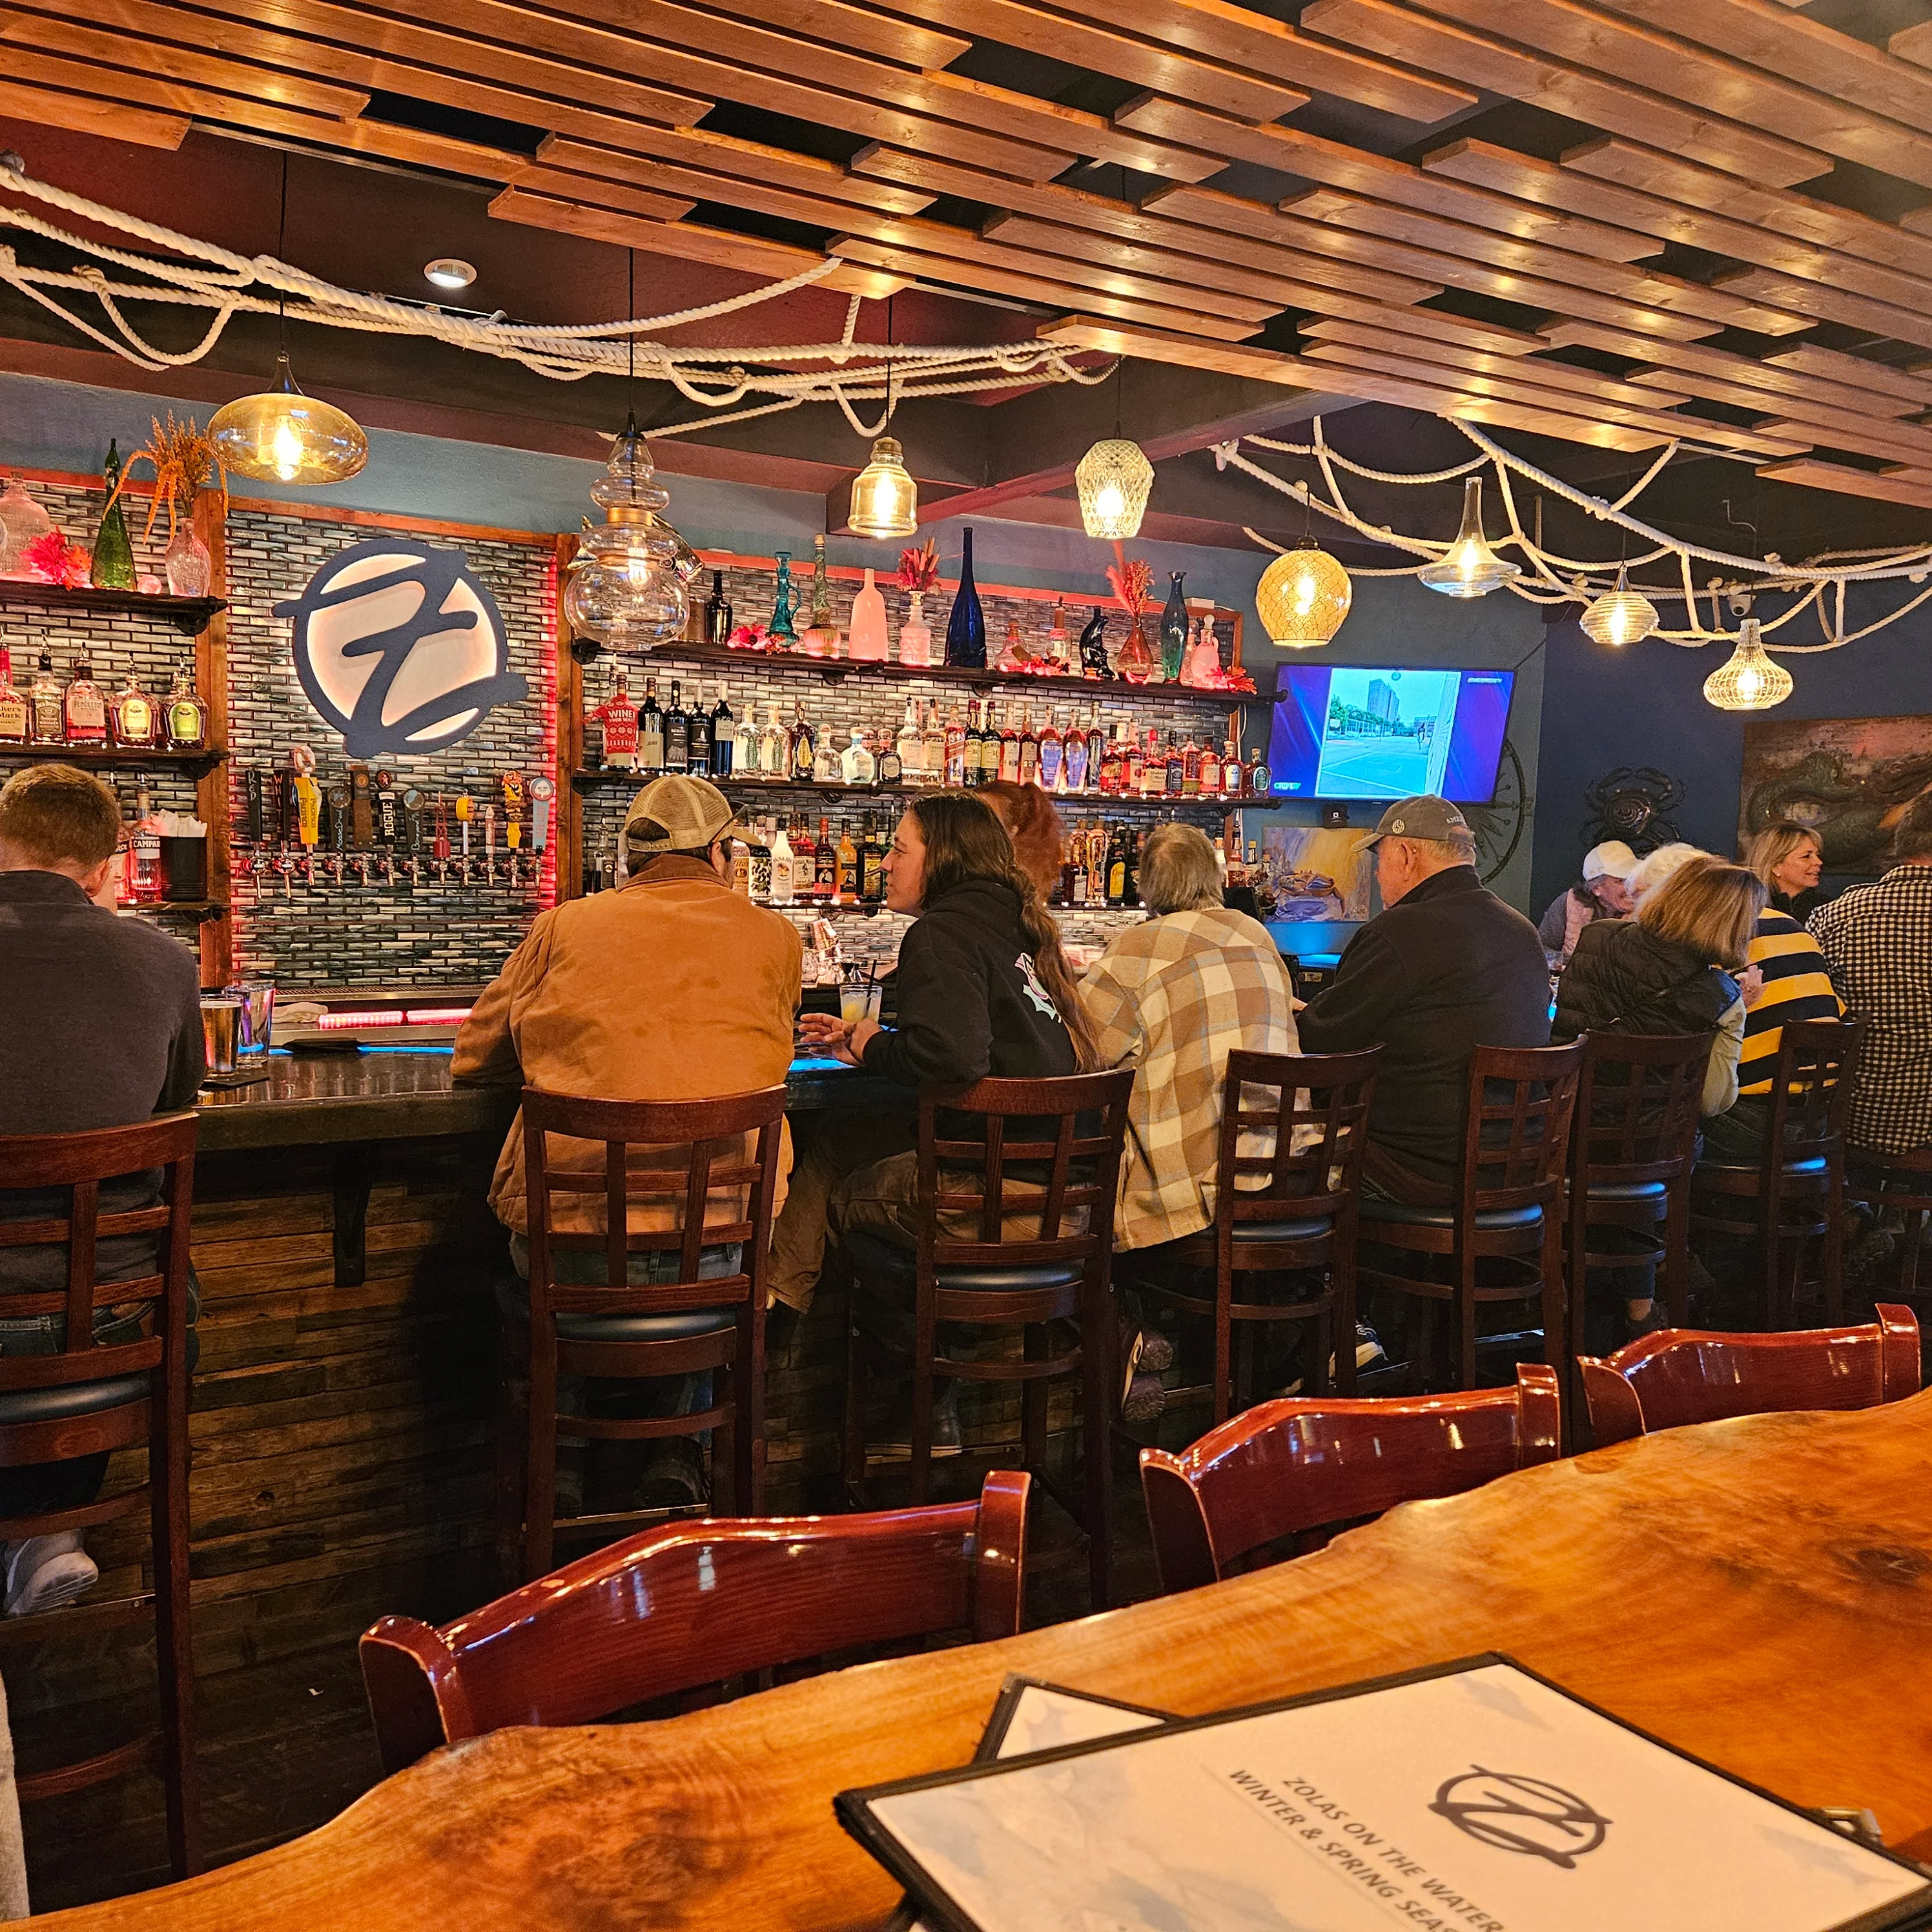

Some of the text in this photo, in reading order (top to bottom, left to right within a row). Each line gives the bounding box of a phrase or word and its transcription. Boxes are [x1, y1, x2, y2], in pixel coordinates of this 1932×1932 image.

[248, 771, 256, 801] RED
[382, 802, 395, 836] ROGUE
[1229, 1769, 1306, 1826] WINTER
[1299, 1827, 1323, 1840] &
[1317, 1842, 1403, 1898] SPRING
[1282, 1776, 1505, 1932] ZOLAS ON THE WATER
